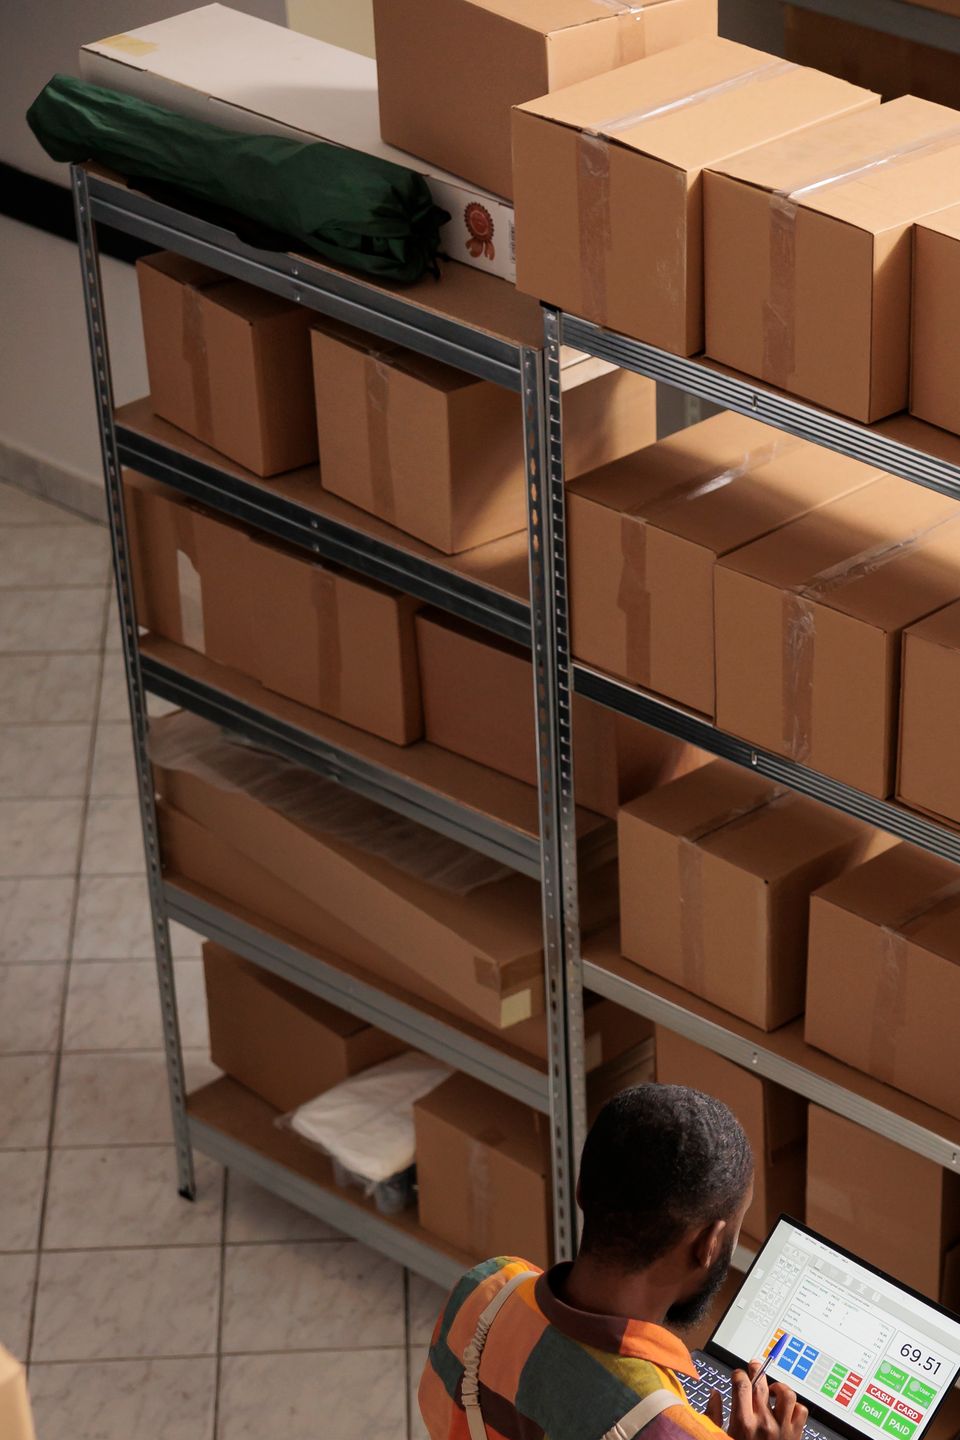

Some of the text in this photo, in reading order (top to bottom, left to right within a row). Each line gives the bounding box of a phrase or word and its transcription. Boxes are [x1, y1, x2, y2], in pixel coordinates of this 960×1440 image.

[900, 1343, 941, 1375] 69.51
[889, 1369, 901, 1379] User
[870, 1387, 891, 1404] CASH
[920, 1386, 931, 1396] User
[861, 1401, 883, 1419] Total
[897, 1403, 919, 1420] CARD
[889, 1419, 911, 1435] PAID
